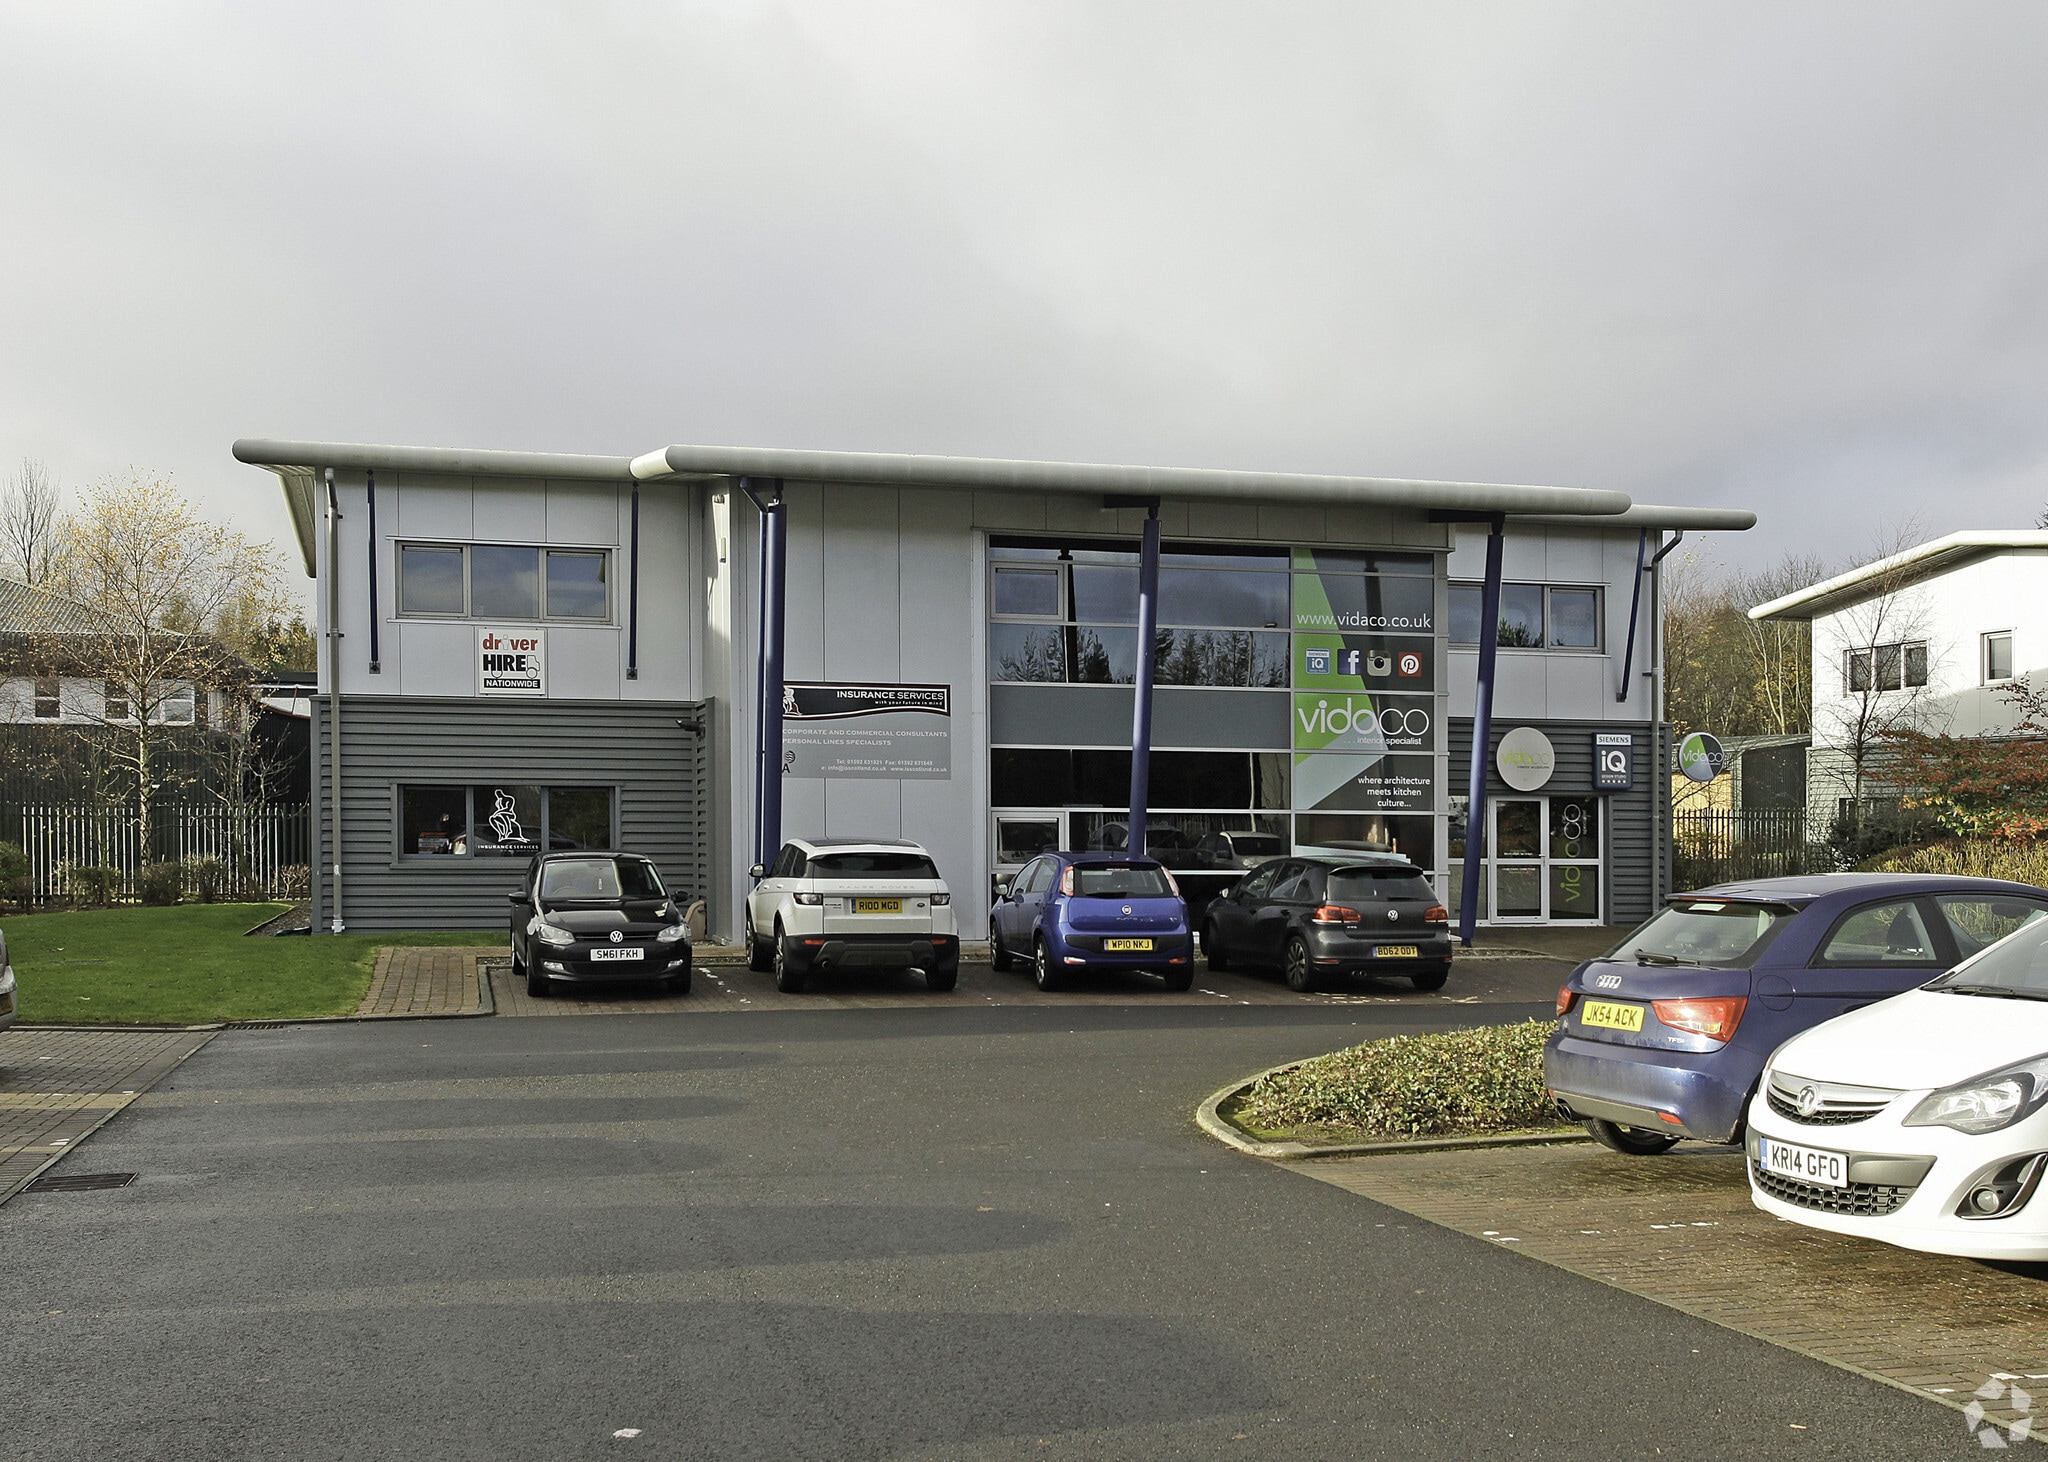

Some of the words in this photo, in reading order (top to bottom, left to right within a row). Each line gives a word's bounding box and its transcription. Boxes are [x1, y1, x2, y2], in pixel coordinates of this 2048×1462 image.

[1297, 611, 1431, 628] www.vidaco.co.uk
[482, 633, 538, 651] driver
[483, 654, 526, 672] HIRE
[1311, 658, 1324, 669] iQ
[486, 679, 538, 688] NATIONWIDE
[836, 690, 895, 699] INSURANCE
[897, 691, 944, 700] SERVICES
[1297, 697, 1430, 736] vidaco
[1385, 733, 1422, 746] specialist
[1598, 736, 1629, 744] SIEMENS
[1601, 750, 1627, 773] iQ
[1682, 749, 1723, 763] vidaco
[1358, 777, 1383, 785] where
[1384, 776, 1431, 786] architecture
[1393, 787, 1422, 796] kitchen
[881, 901, 899, 910] MGD
[1133, 940, 1150, 949] NKJ
[620, 949, 638, 959] FKH
[1613, 1007, 1638, 1027] ACK
[1772, 1144, 1803, 1173] KR14
[1807, 1152, 1839, 1181] GFO
